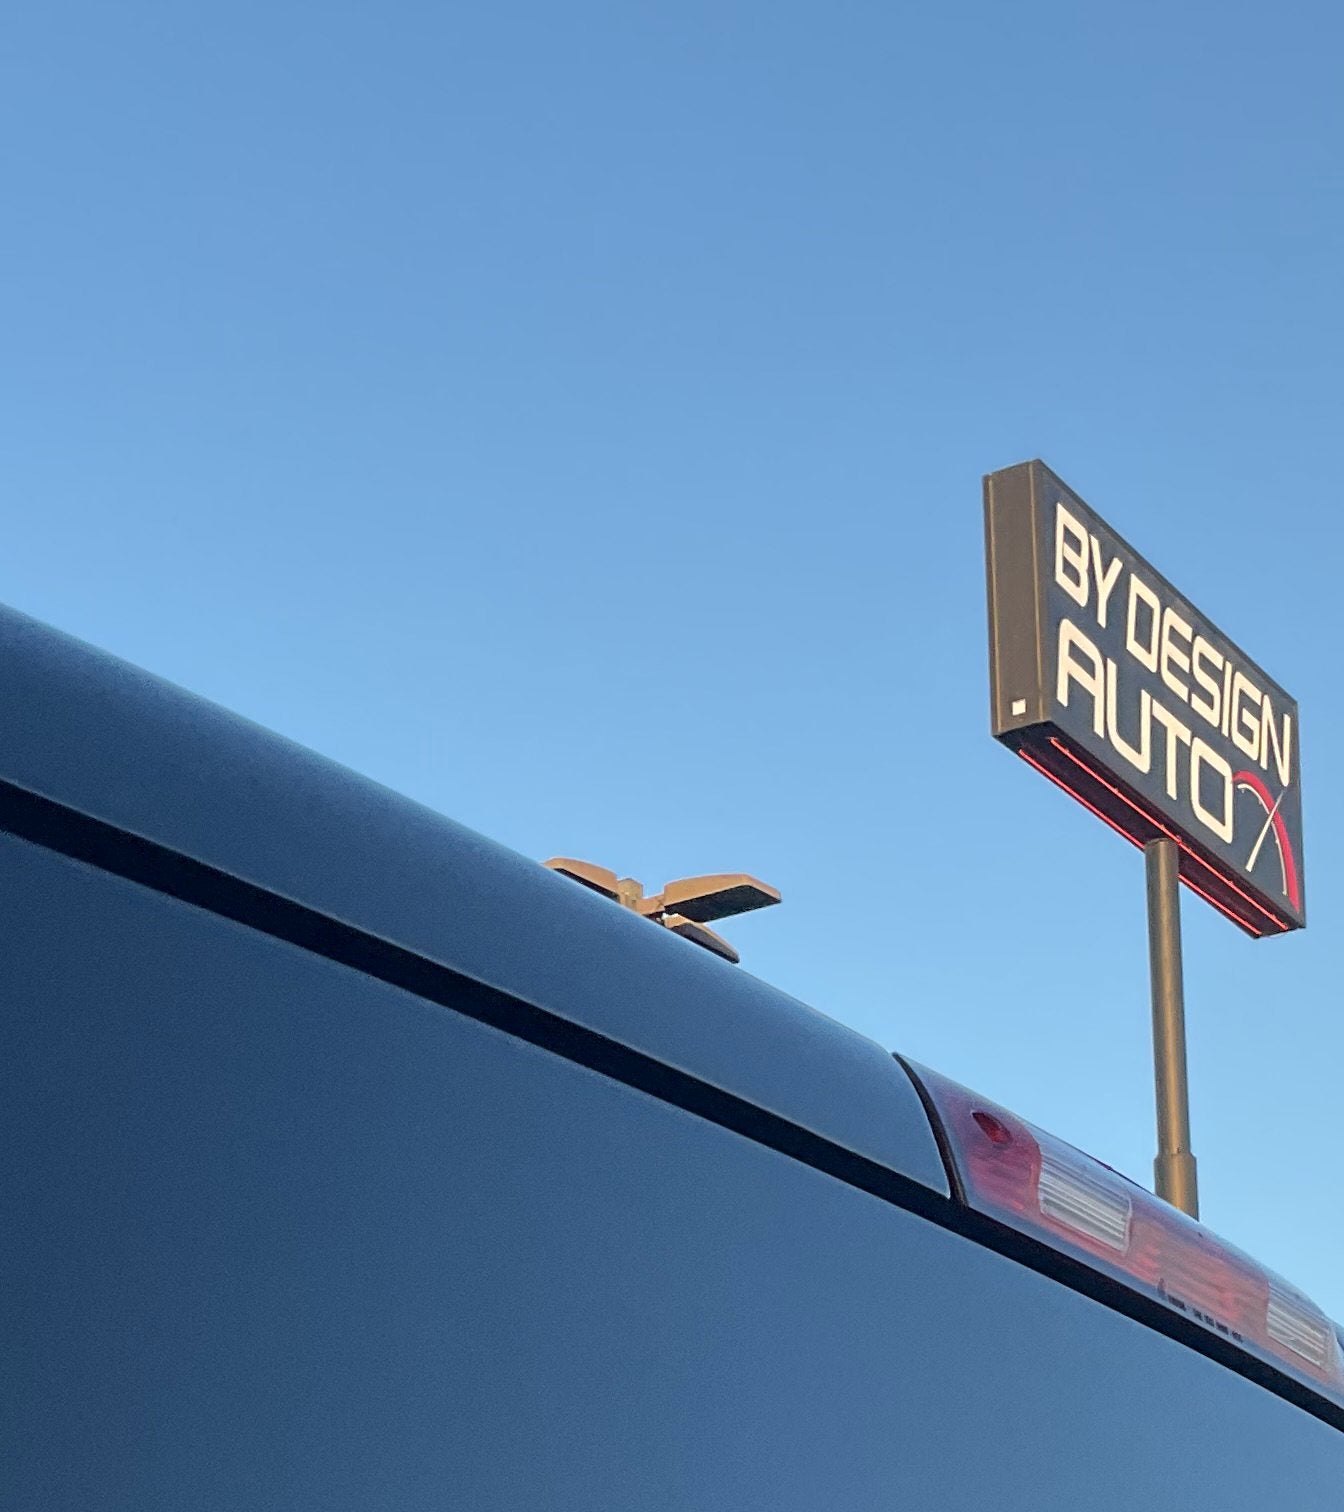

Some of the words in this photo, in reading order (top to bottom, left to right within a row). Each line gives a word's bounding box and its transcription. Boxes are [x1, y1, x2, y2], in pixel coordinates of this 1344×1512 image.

[1055, 502, 1123, 628] BY
[1126, 573, 1291, 787] DESIGN
[1056, 619, 1233, 843] AUTO
